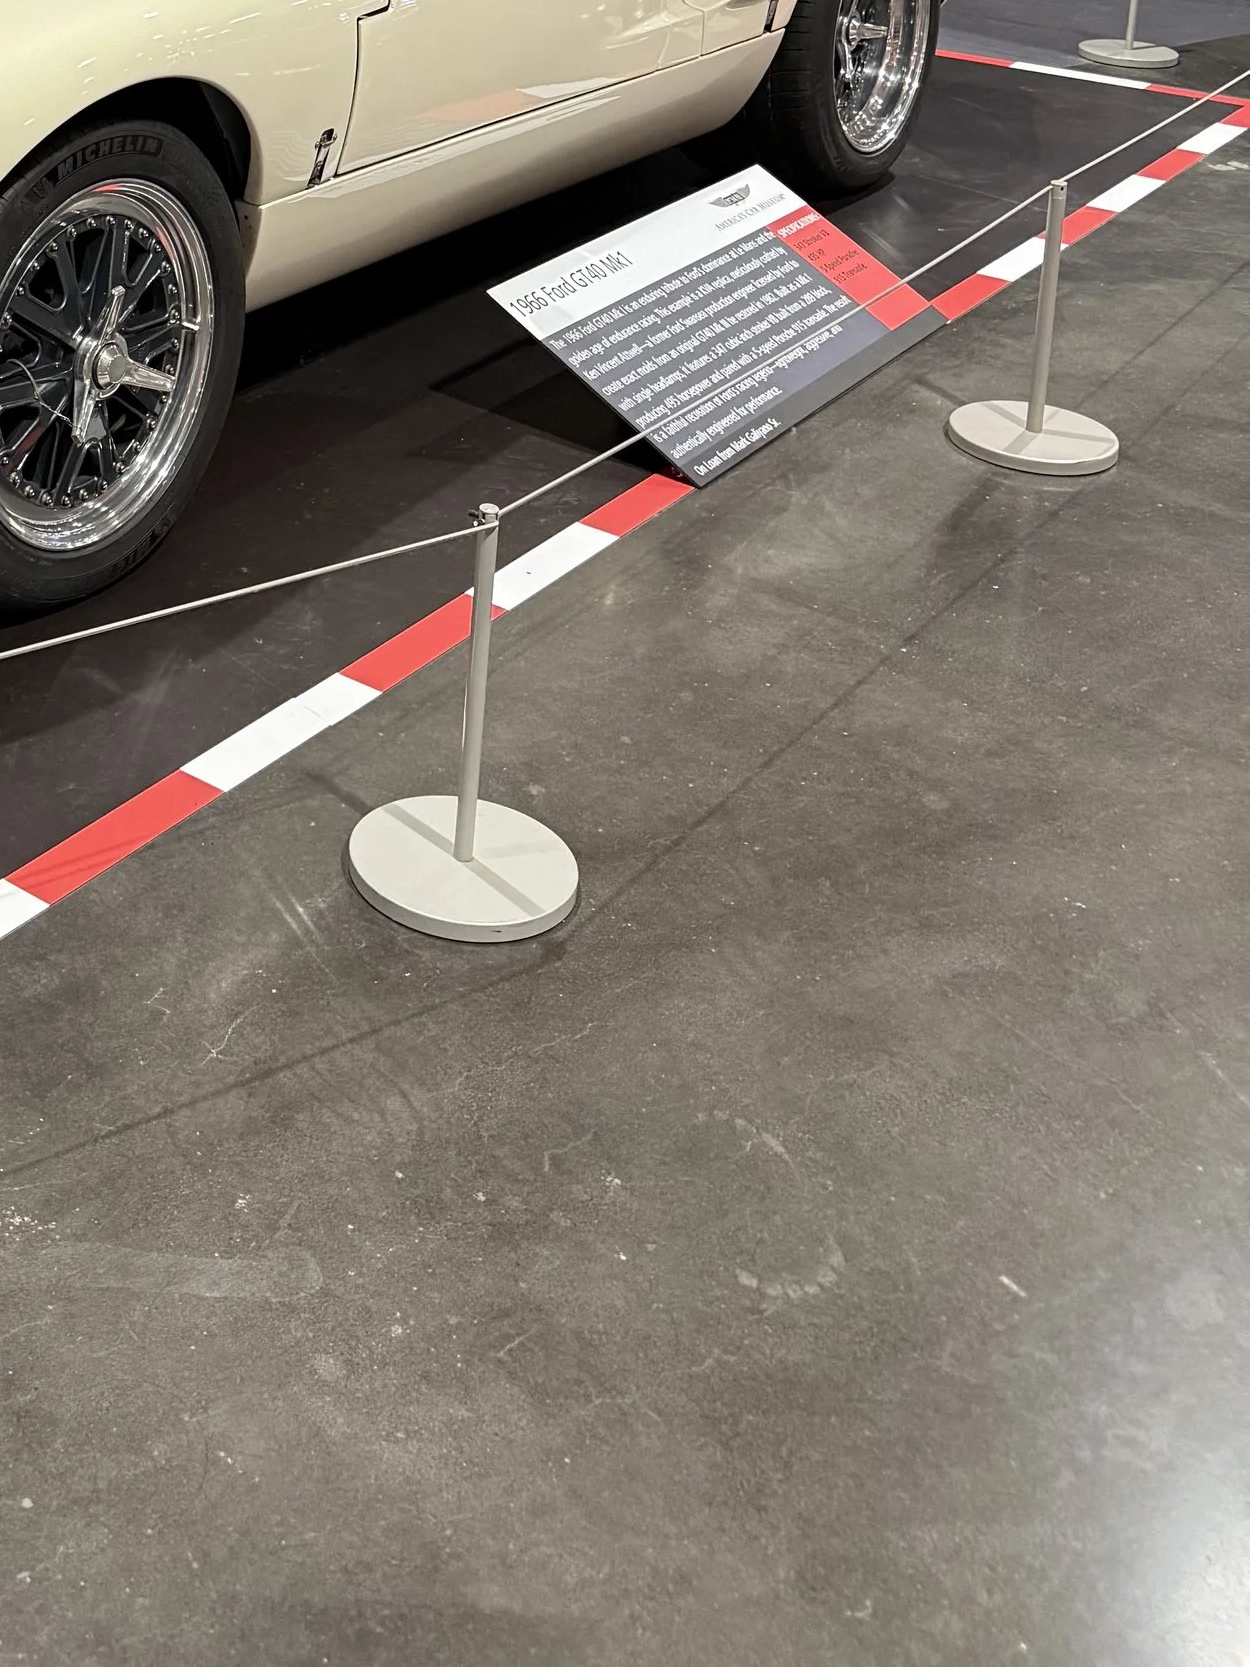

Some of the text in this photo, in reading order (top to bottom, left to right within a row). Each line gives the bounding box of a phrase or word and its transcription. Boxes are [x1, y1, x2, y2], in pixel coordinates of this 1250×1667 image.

[57, 136, 159, 181] MICHELIN
[510, 251, 632, 316] 1966 Ford GT40 Mk1
[694, 436, 751, 475] On Loan from Mark
